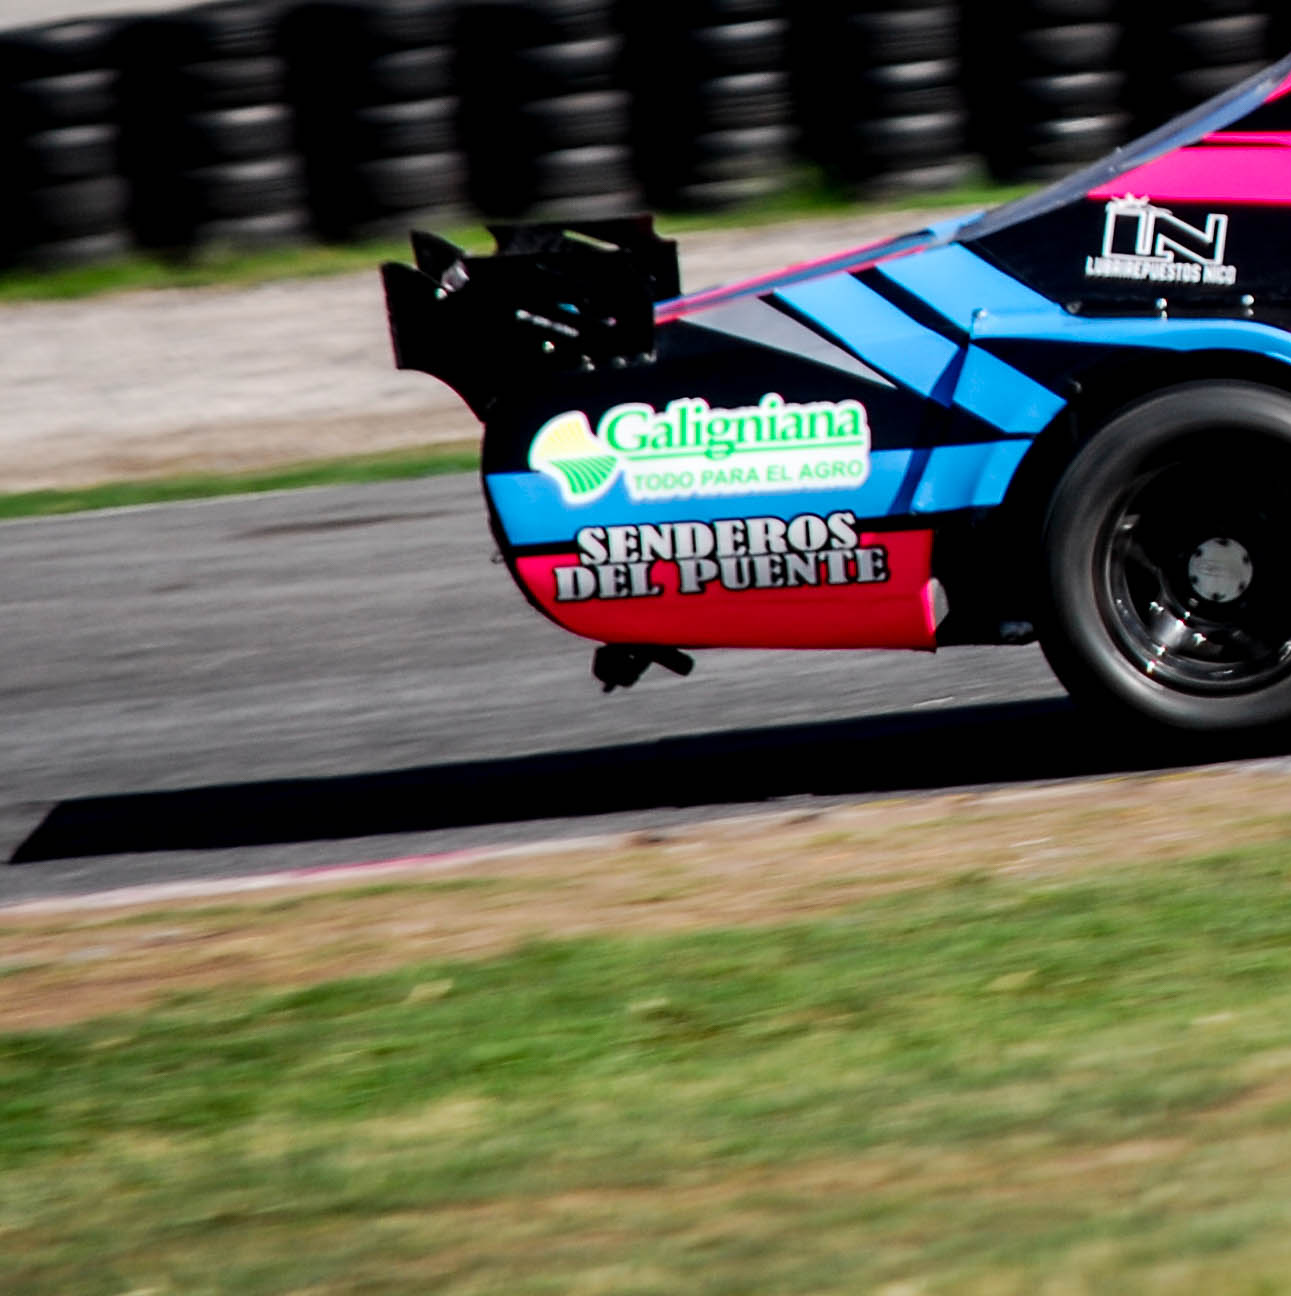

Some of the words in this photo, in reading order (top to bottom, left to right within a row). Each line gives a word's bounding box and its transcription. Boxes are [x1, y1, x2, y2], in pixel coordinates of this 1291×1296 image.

[605, 399, 863, 461] Galigniana
[633, 472, 695, 492] TODO
[700, 466, 760, 487] PARA
[766, 463, 793, 482] EL
[798, 459, 864, 481] AGRO
[575, 510, 860, 567] SENDEROS
[553, 562, 663, 602] DEL
[677, 546, 890, 594] PUENTE
